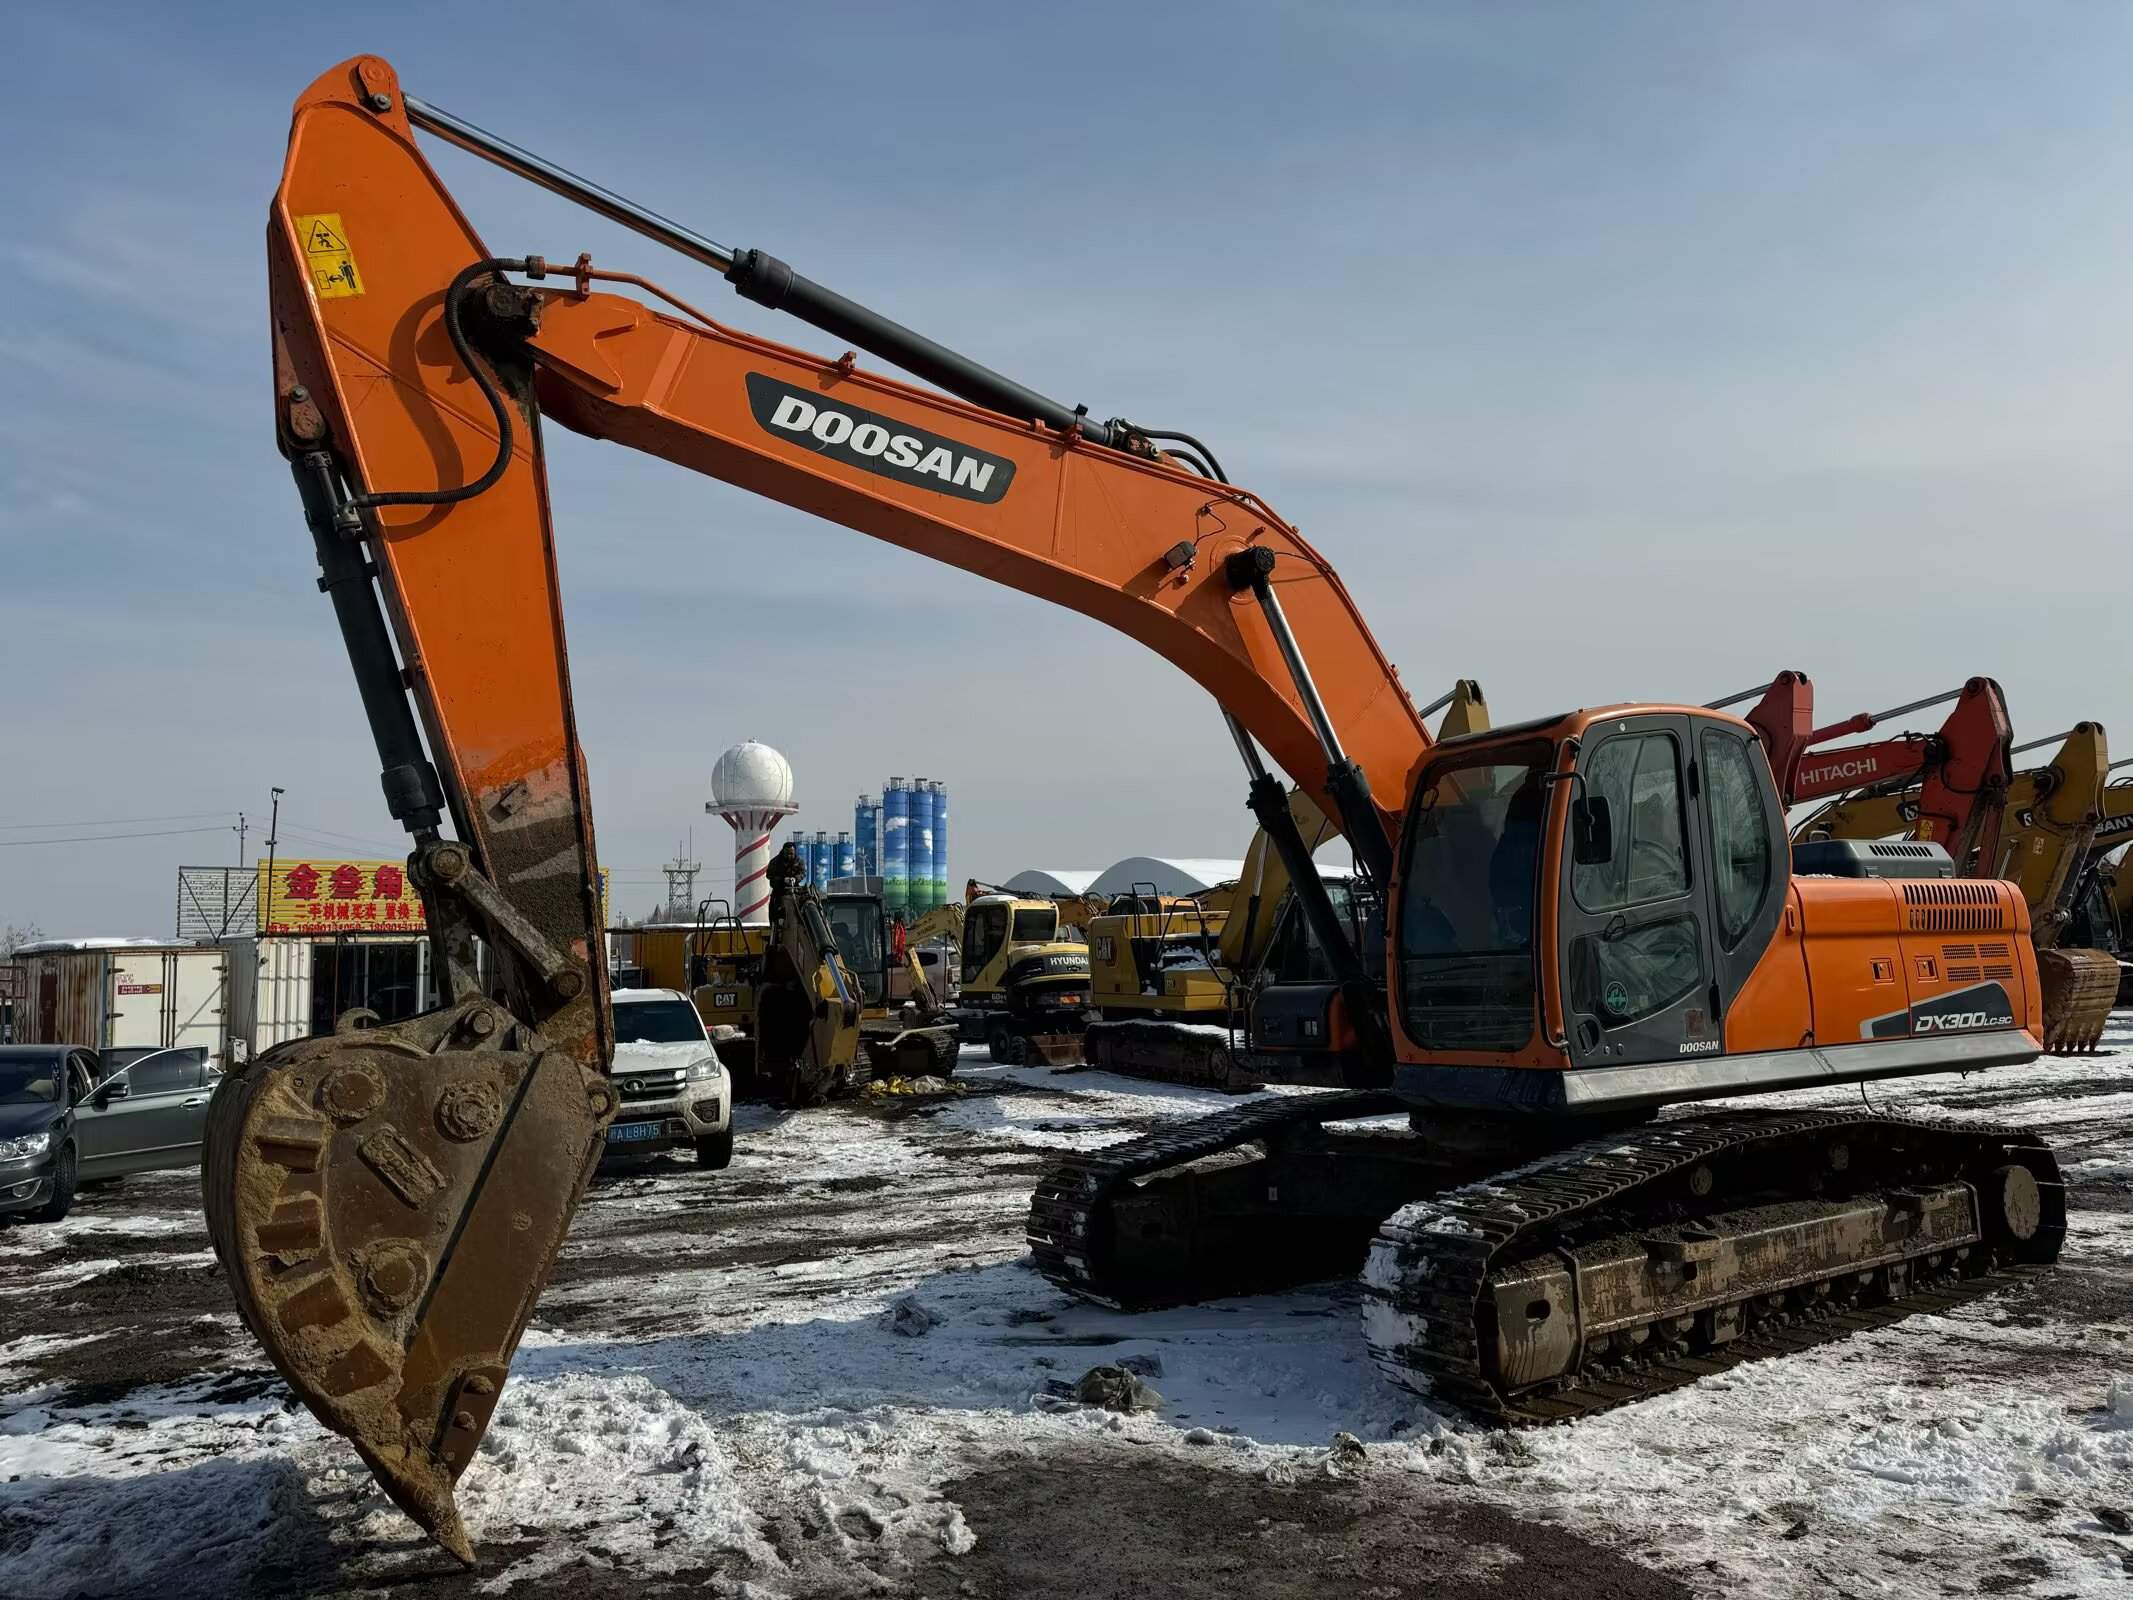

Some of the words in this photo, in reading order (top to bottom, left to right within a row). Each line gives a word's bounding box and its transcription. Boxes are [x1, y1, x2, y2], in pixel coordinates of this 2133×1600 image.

[770, 395, 996, 493] DOOSAN
[1801, 757, 1878, 785] HITACHI
[1096, 936, 1111, 960] CAT
[715, 993, 735, 1006] CAT
[1680, 1040, 1719, 1053] DOOSAN
